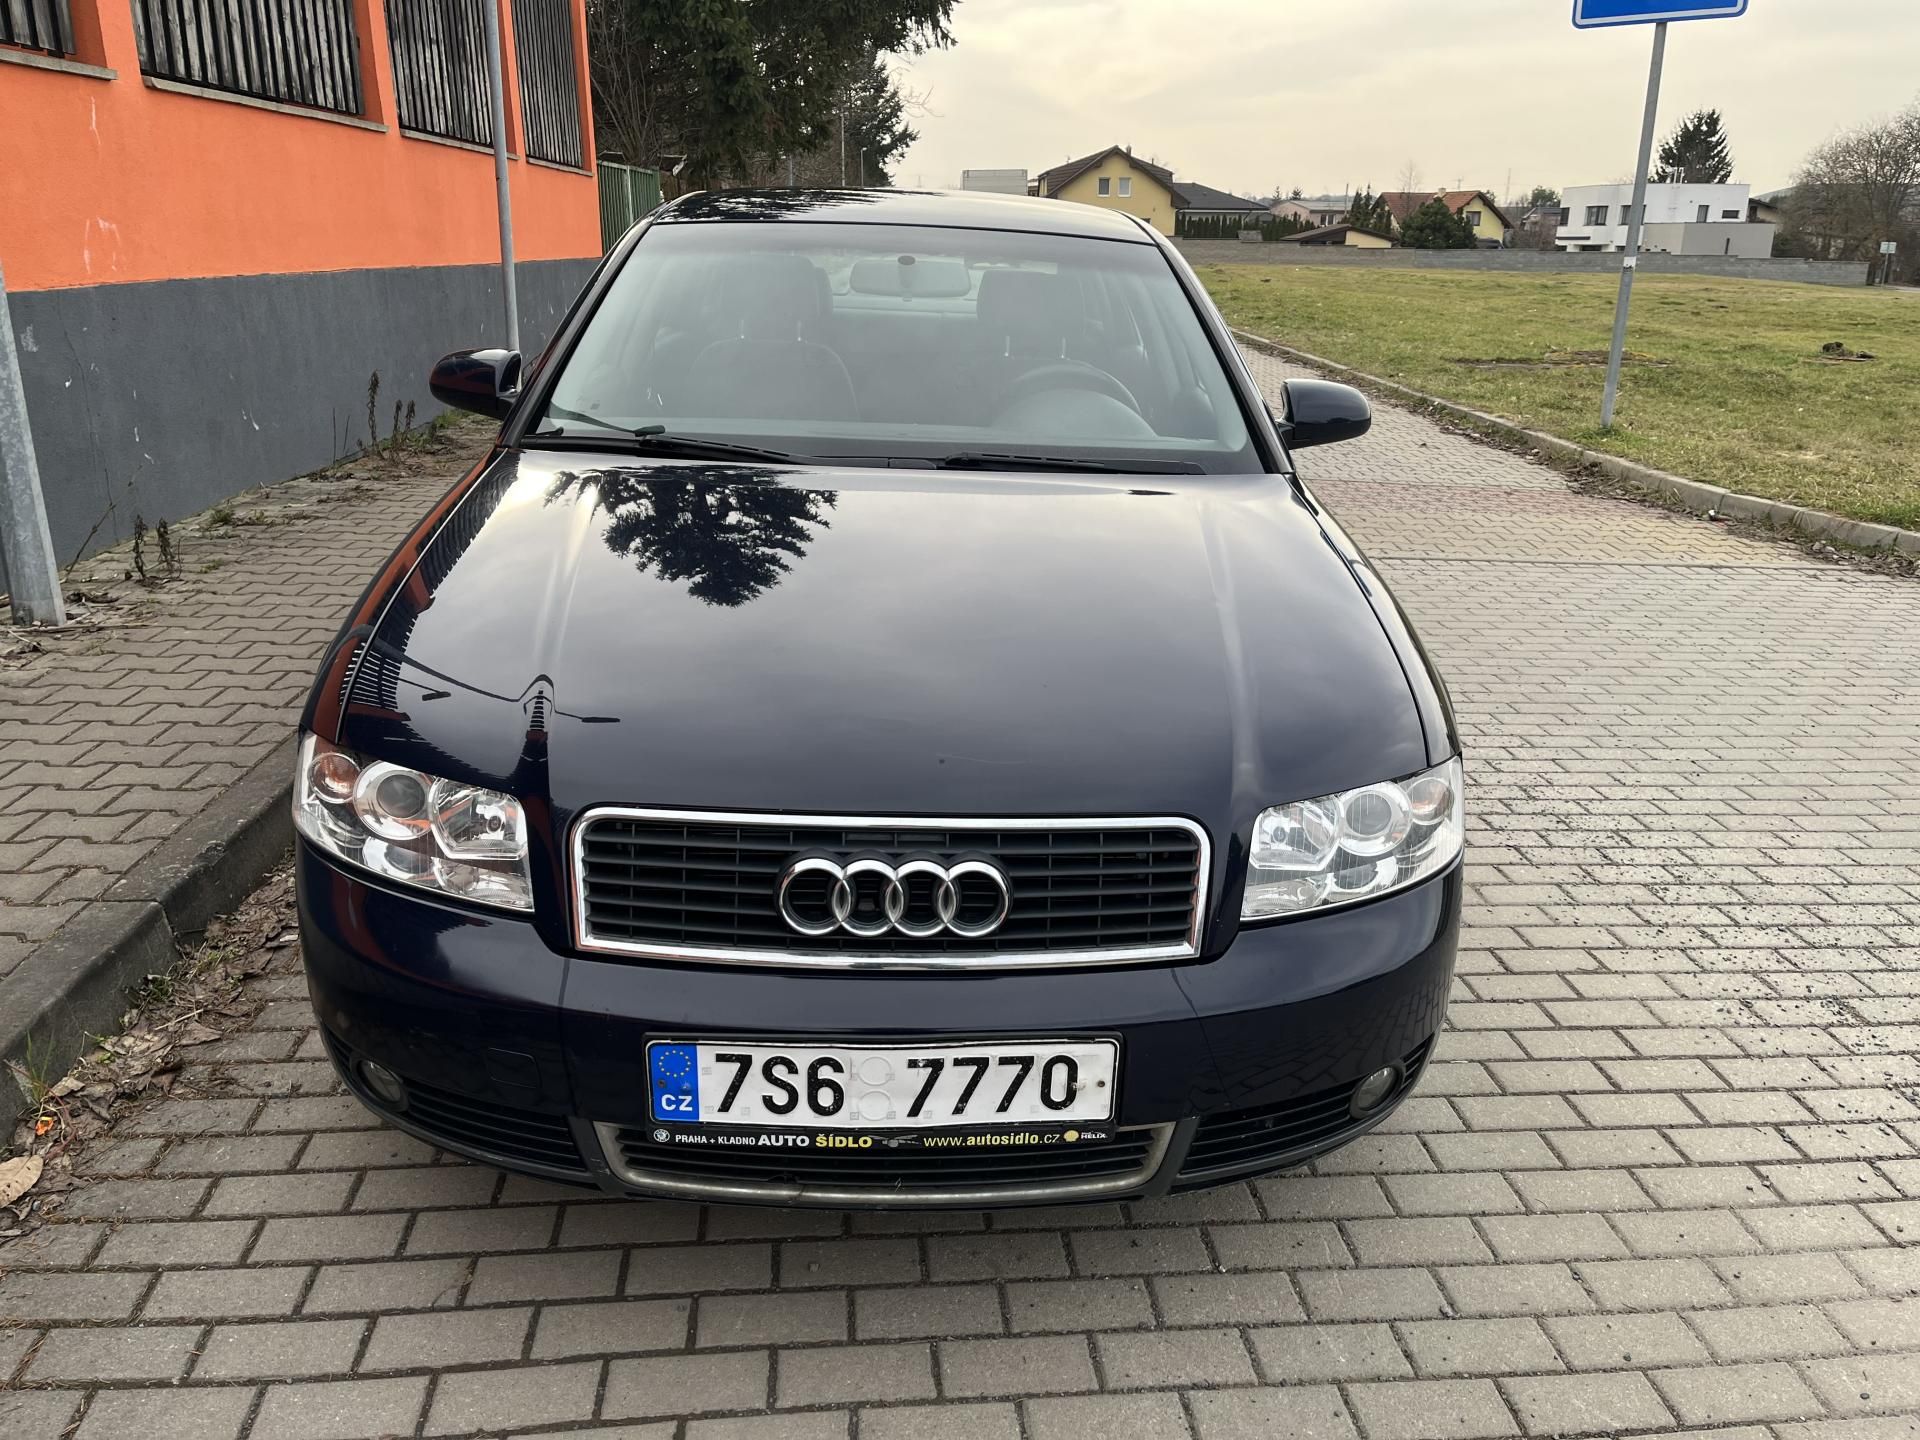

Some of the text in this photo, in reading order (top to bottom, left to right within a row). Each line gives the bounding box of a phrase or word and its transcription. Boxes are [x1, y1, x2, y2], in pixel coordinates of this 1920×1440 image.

[715, 1053, 1078, 1117] 7S6 7770
[661, 1094, 693, 1111] CZ
[675, 1134, 707, 1144] PRAHA
[718, 1136, 756, 1145] KLADNO
[757, 1134, 810, 1147] AUTO
[815, 1133, 873, 1148] ŠÍDLO
[923, 1132, 1060, 1147] www.autosidlo.cz
